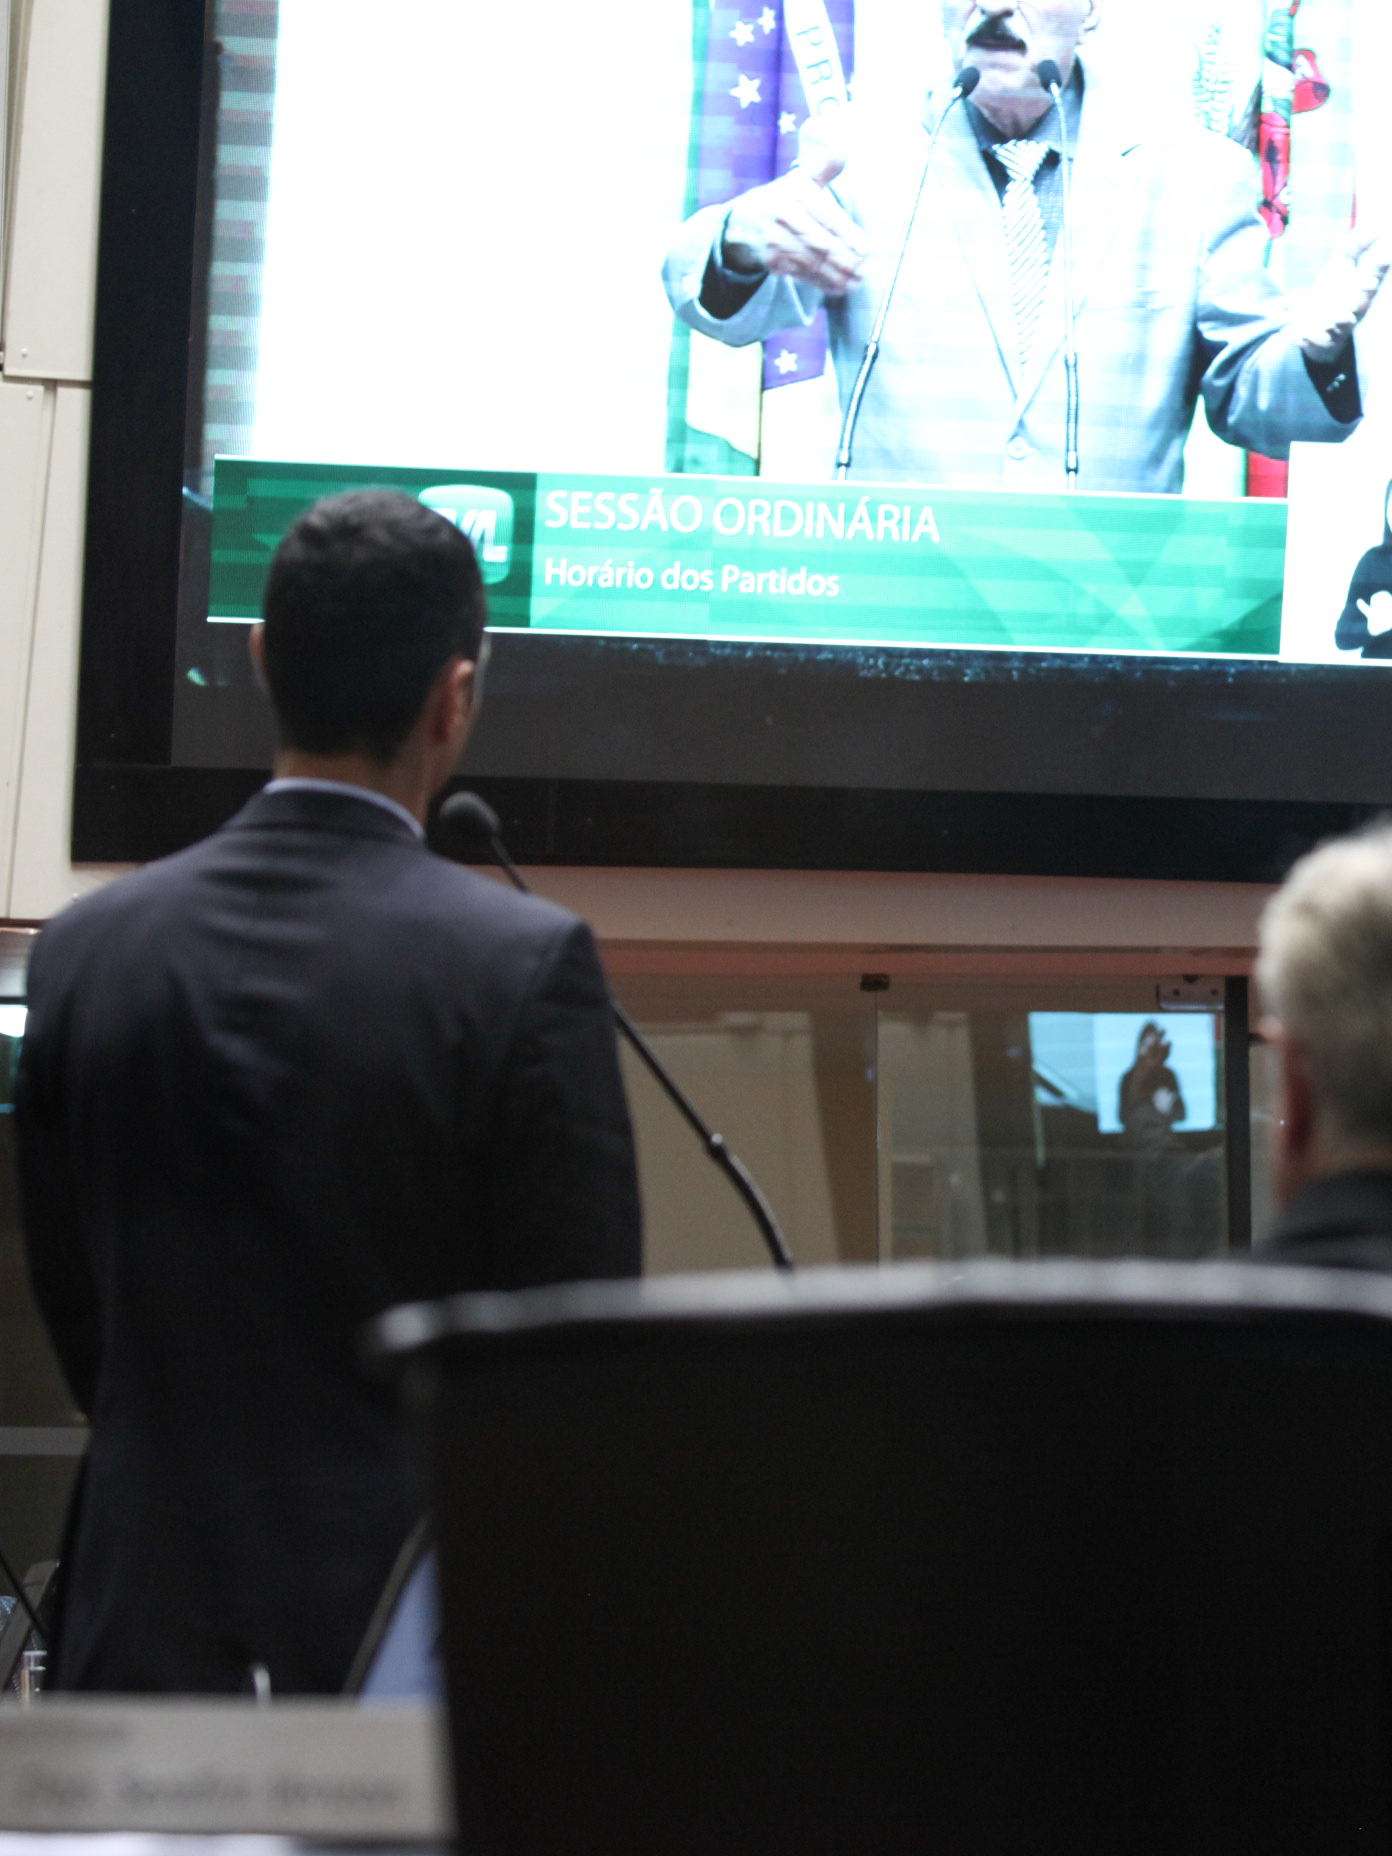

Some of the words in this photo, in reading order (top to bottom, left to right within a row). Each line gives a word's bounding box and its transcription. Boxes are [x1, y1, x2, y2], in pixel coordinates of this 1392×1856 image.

[544, 487, 704, 533] SESSÃO
[713, 496, 941, 544] ORDINÁRIA
[544, 557, 655, 590] Horário
[660, 560, 715, 591] dos
[721, 564, 841, 597] Partidos
